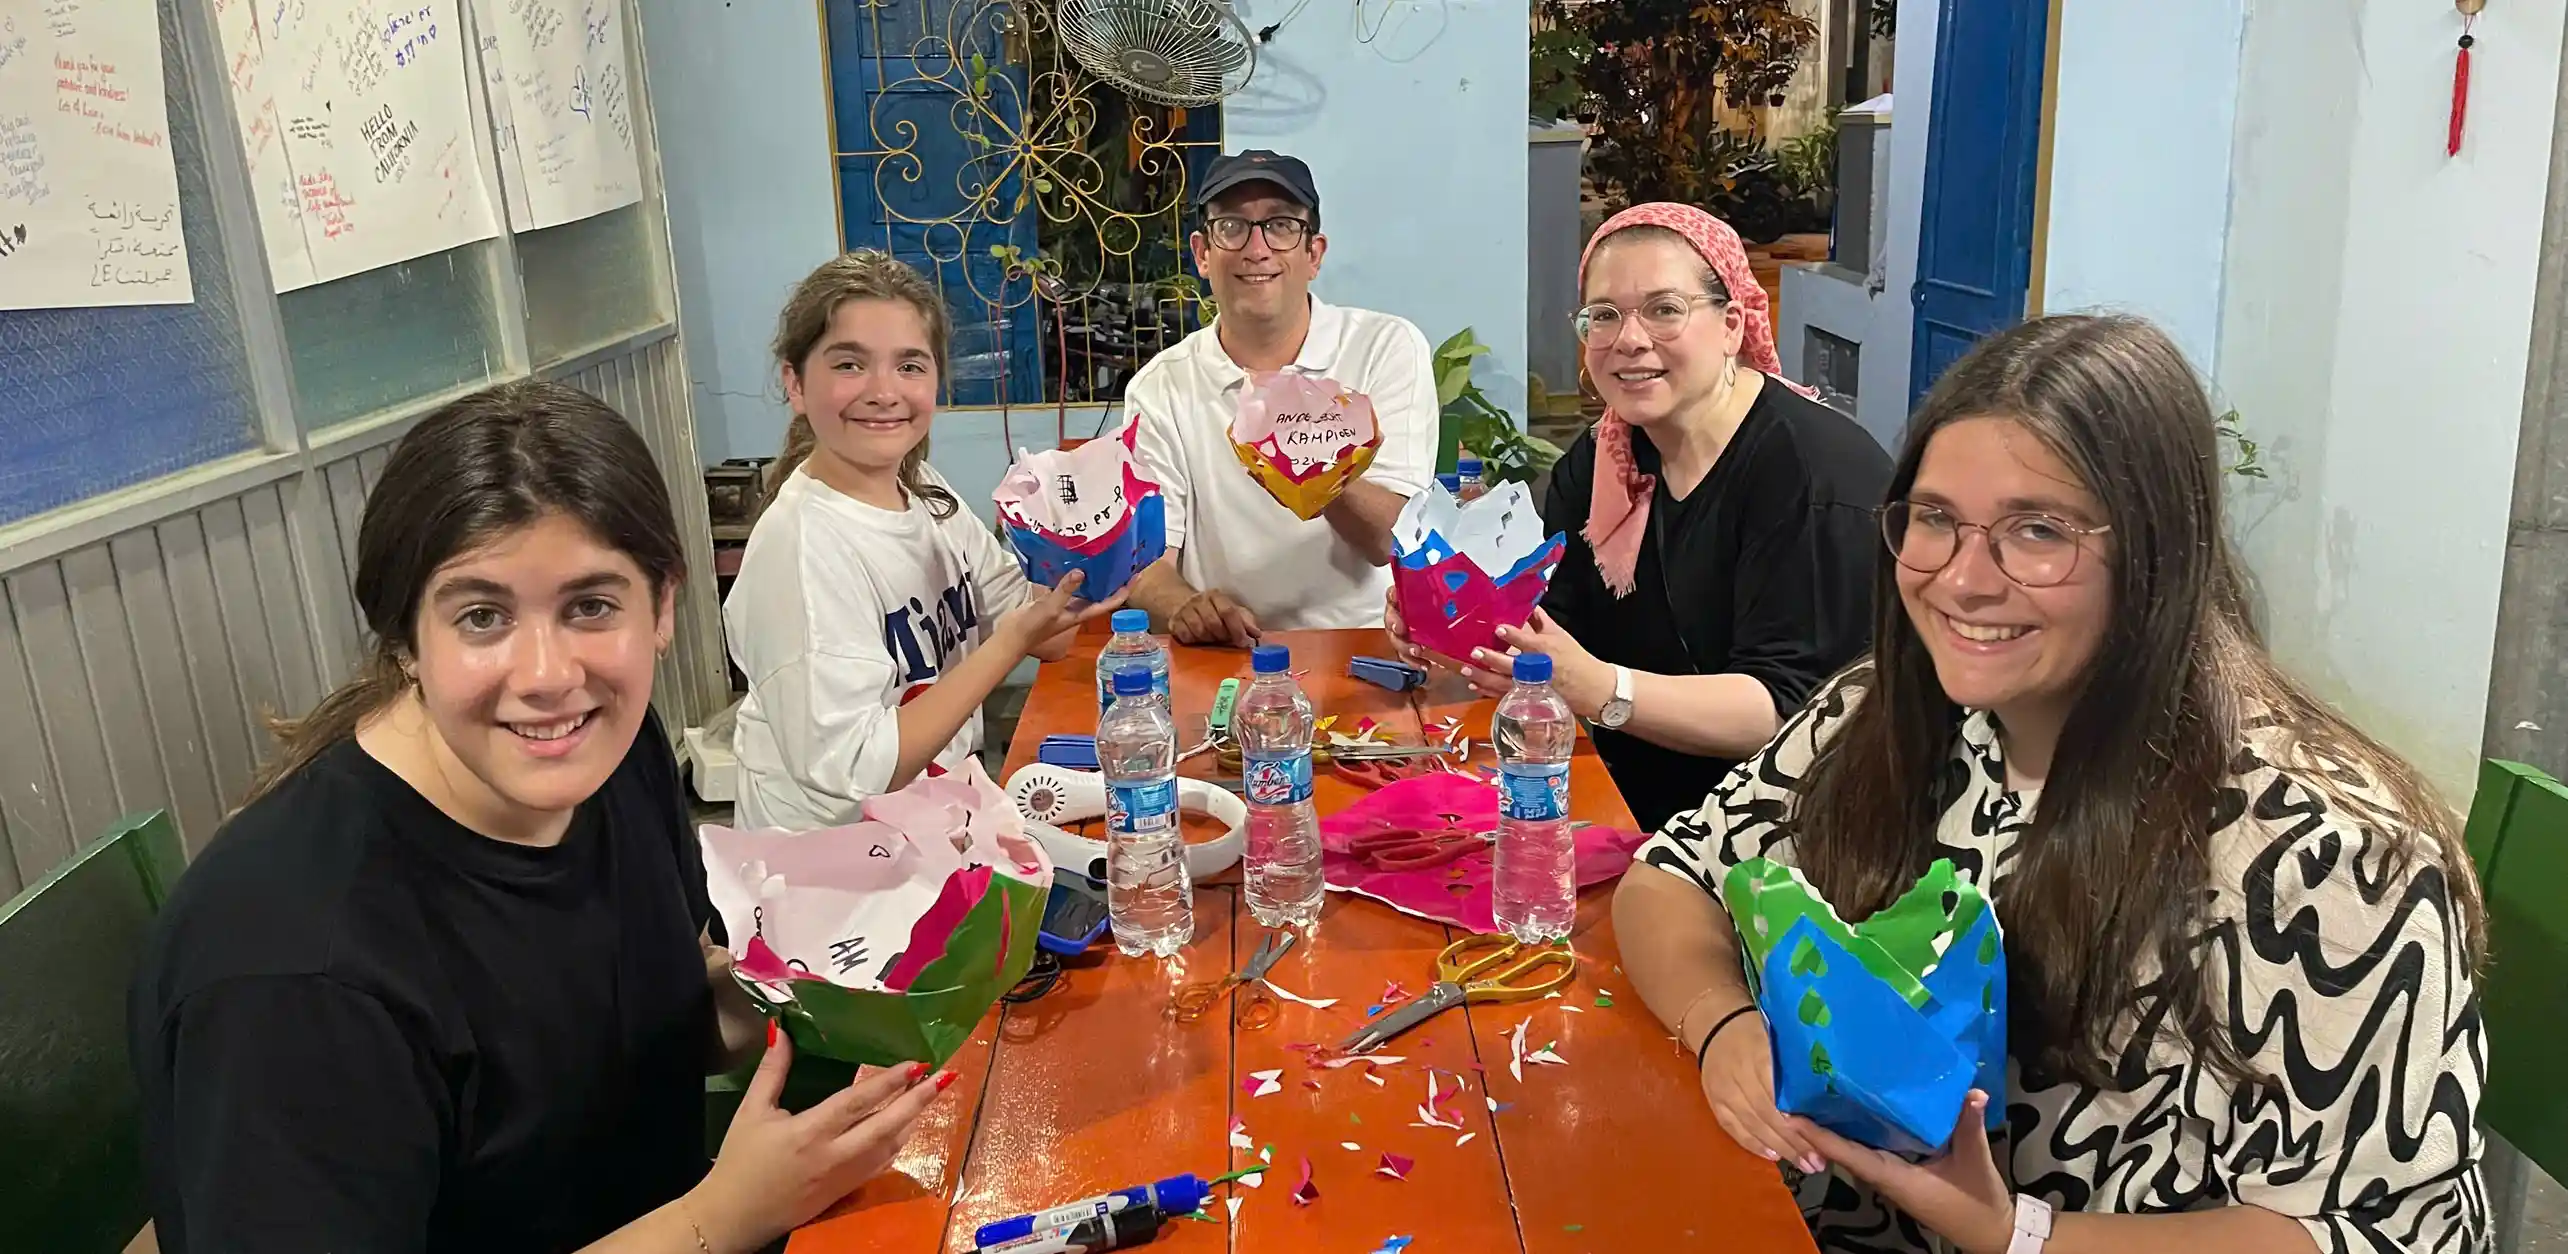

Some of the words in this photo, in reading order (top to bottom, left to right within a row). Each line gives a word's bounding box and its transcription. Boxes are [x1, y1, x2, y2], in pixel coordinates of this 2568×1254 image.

[359, 102, 393, 145] HELLO
[370, 121, 399, 160] FROM
[374, 119, 420, 184] CALIFORNIA
[1286, 426, 1356, 446] KAMPIOEN
[885, 550, 978, 690] Miam
